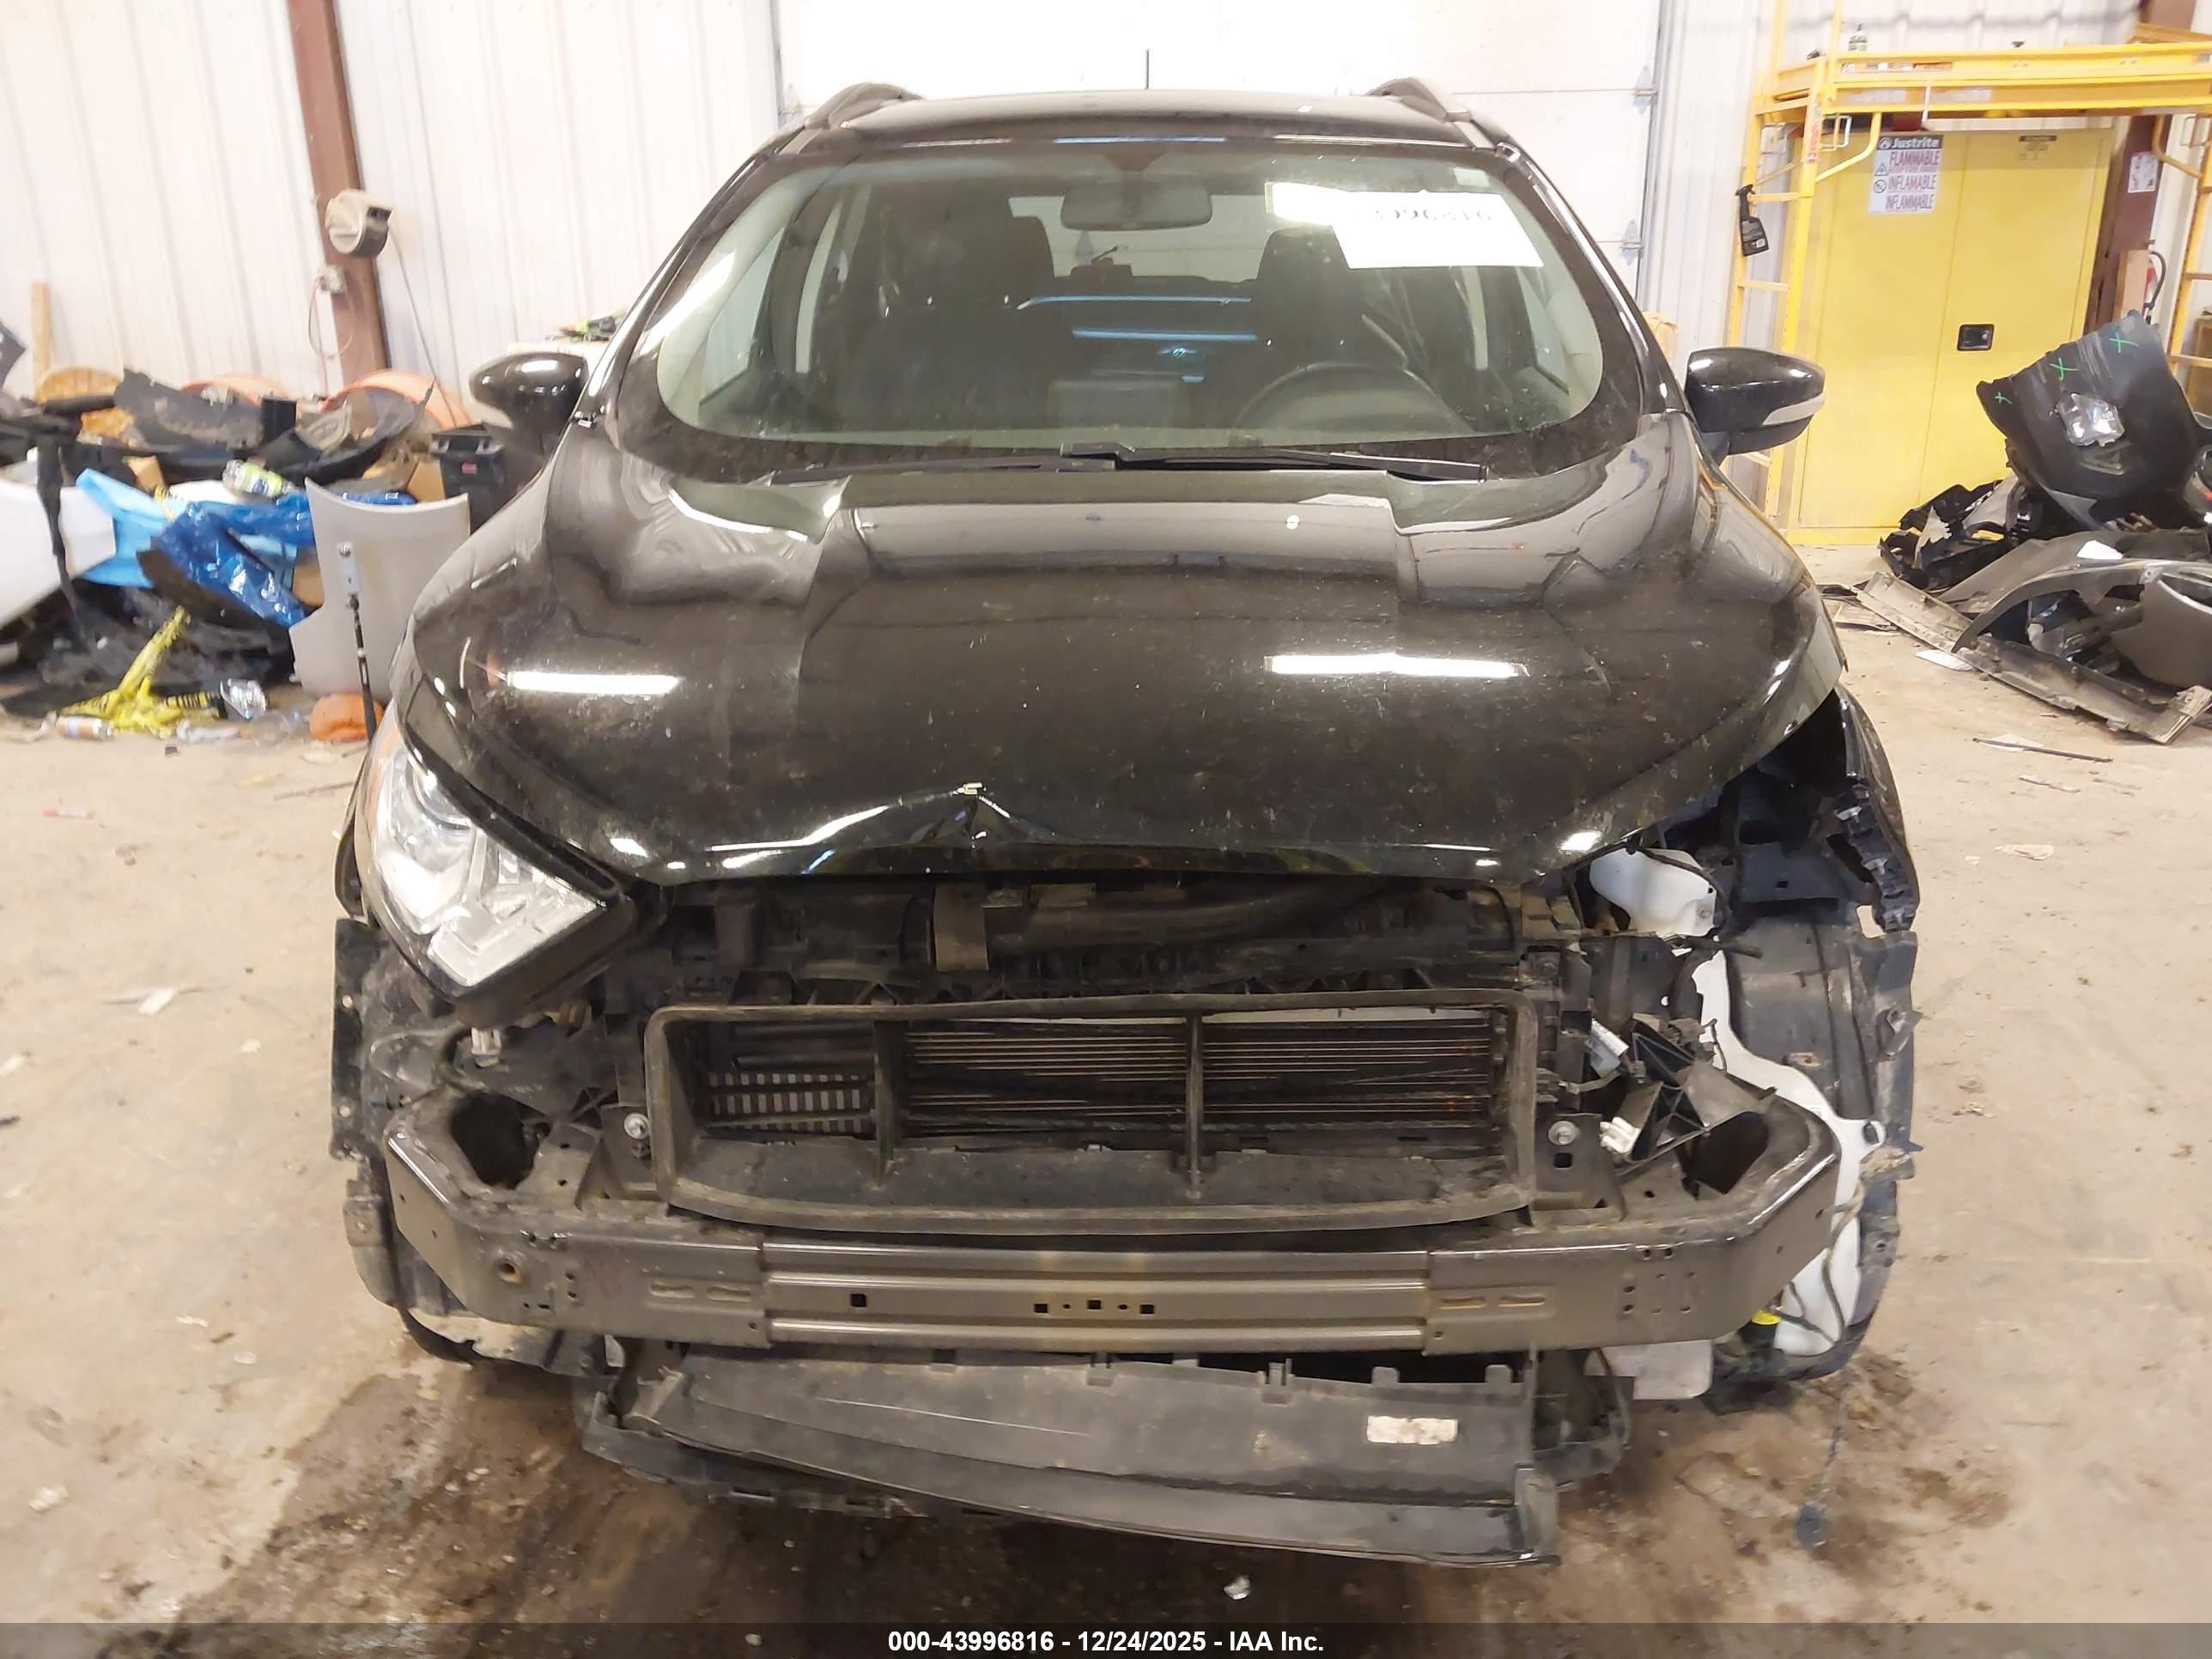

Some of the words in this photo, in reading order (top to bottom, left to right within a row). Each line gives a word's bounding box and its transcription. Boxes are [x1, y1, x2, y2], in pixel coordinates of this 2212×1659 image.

[1892, 137, 1940, 149] Justrite
[1889, 151, 1941, 166] FLAMMABLE
[1887, 174, 1937, 191] INFLAMABLE
[1885, 194, 1935, 210] INFLAMMABLE
